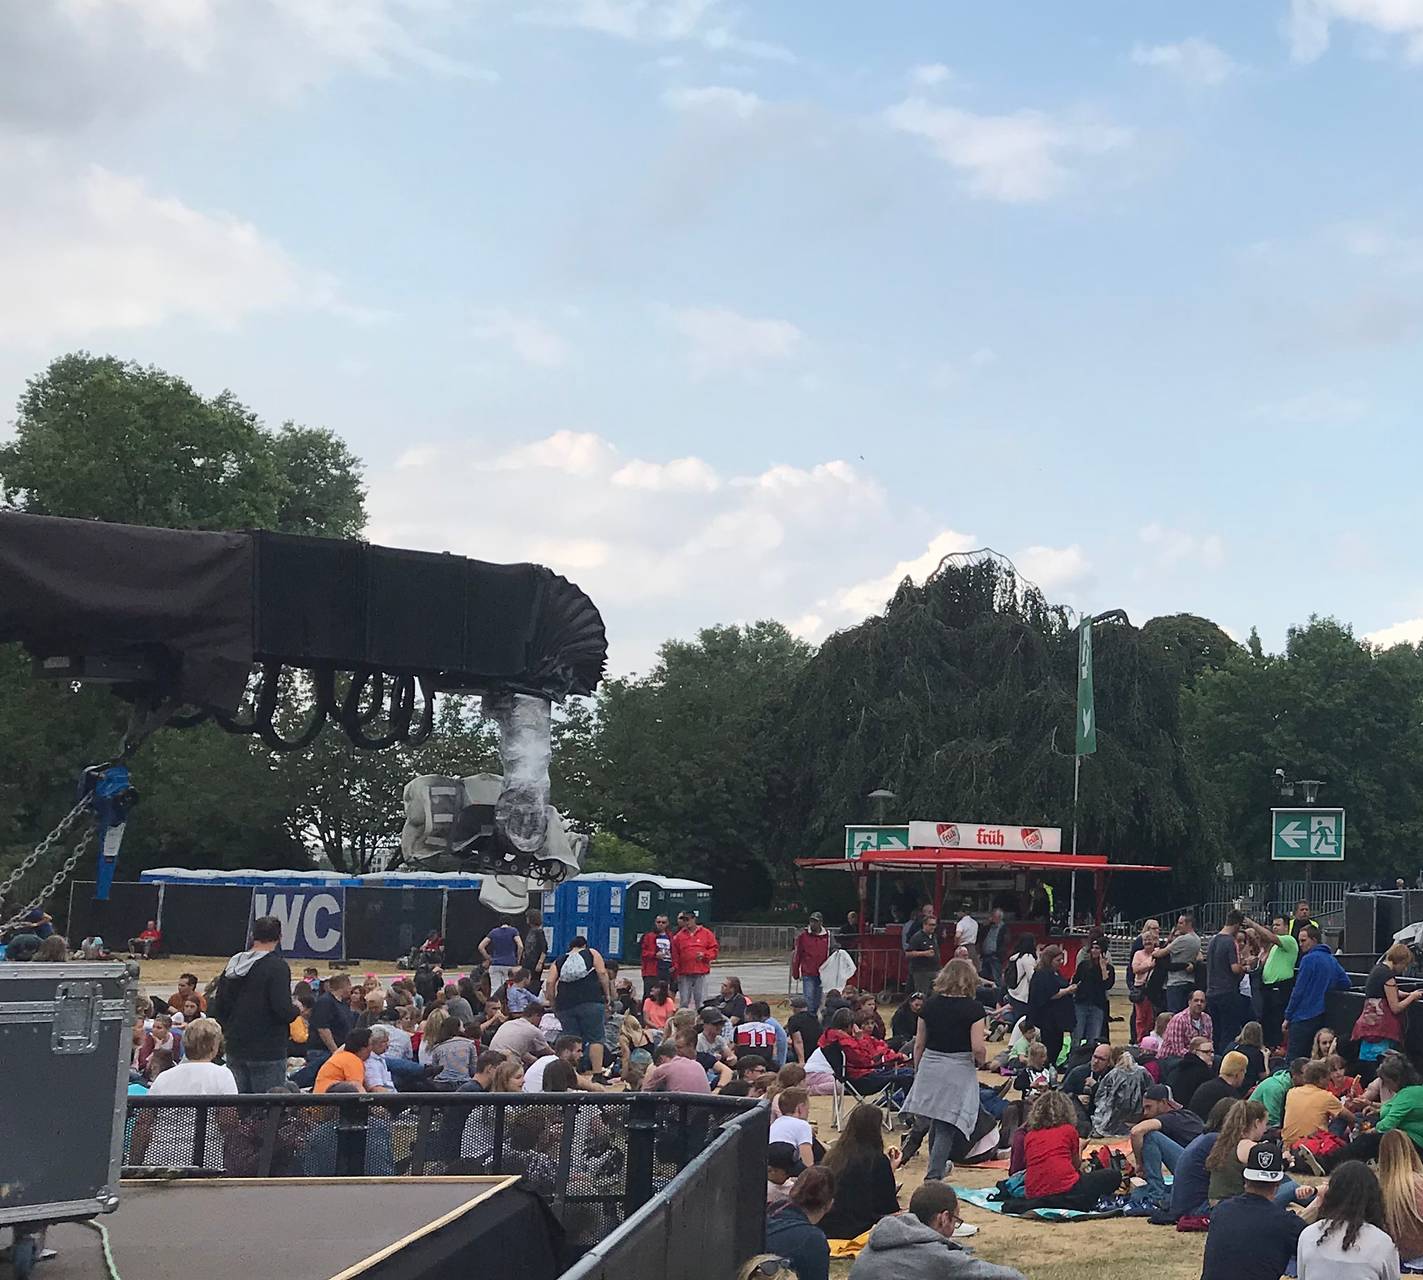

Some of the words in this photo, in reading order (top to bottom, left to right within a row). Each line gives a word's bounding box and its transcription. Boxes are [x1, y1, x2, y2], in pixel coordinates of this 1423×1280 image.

[976, 828, 1004, 847] früh
[255, 893, 341, 953] WC
[748, 1029, 767, 1047] 11
